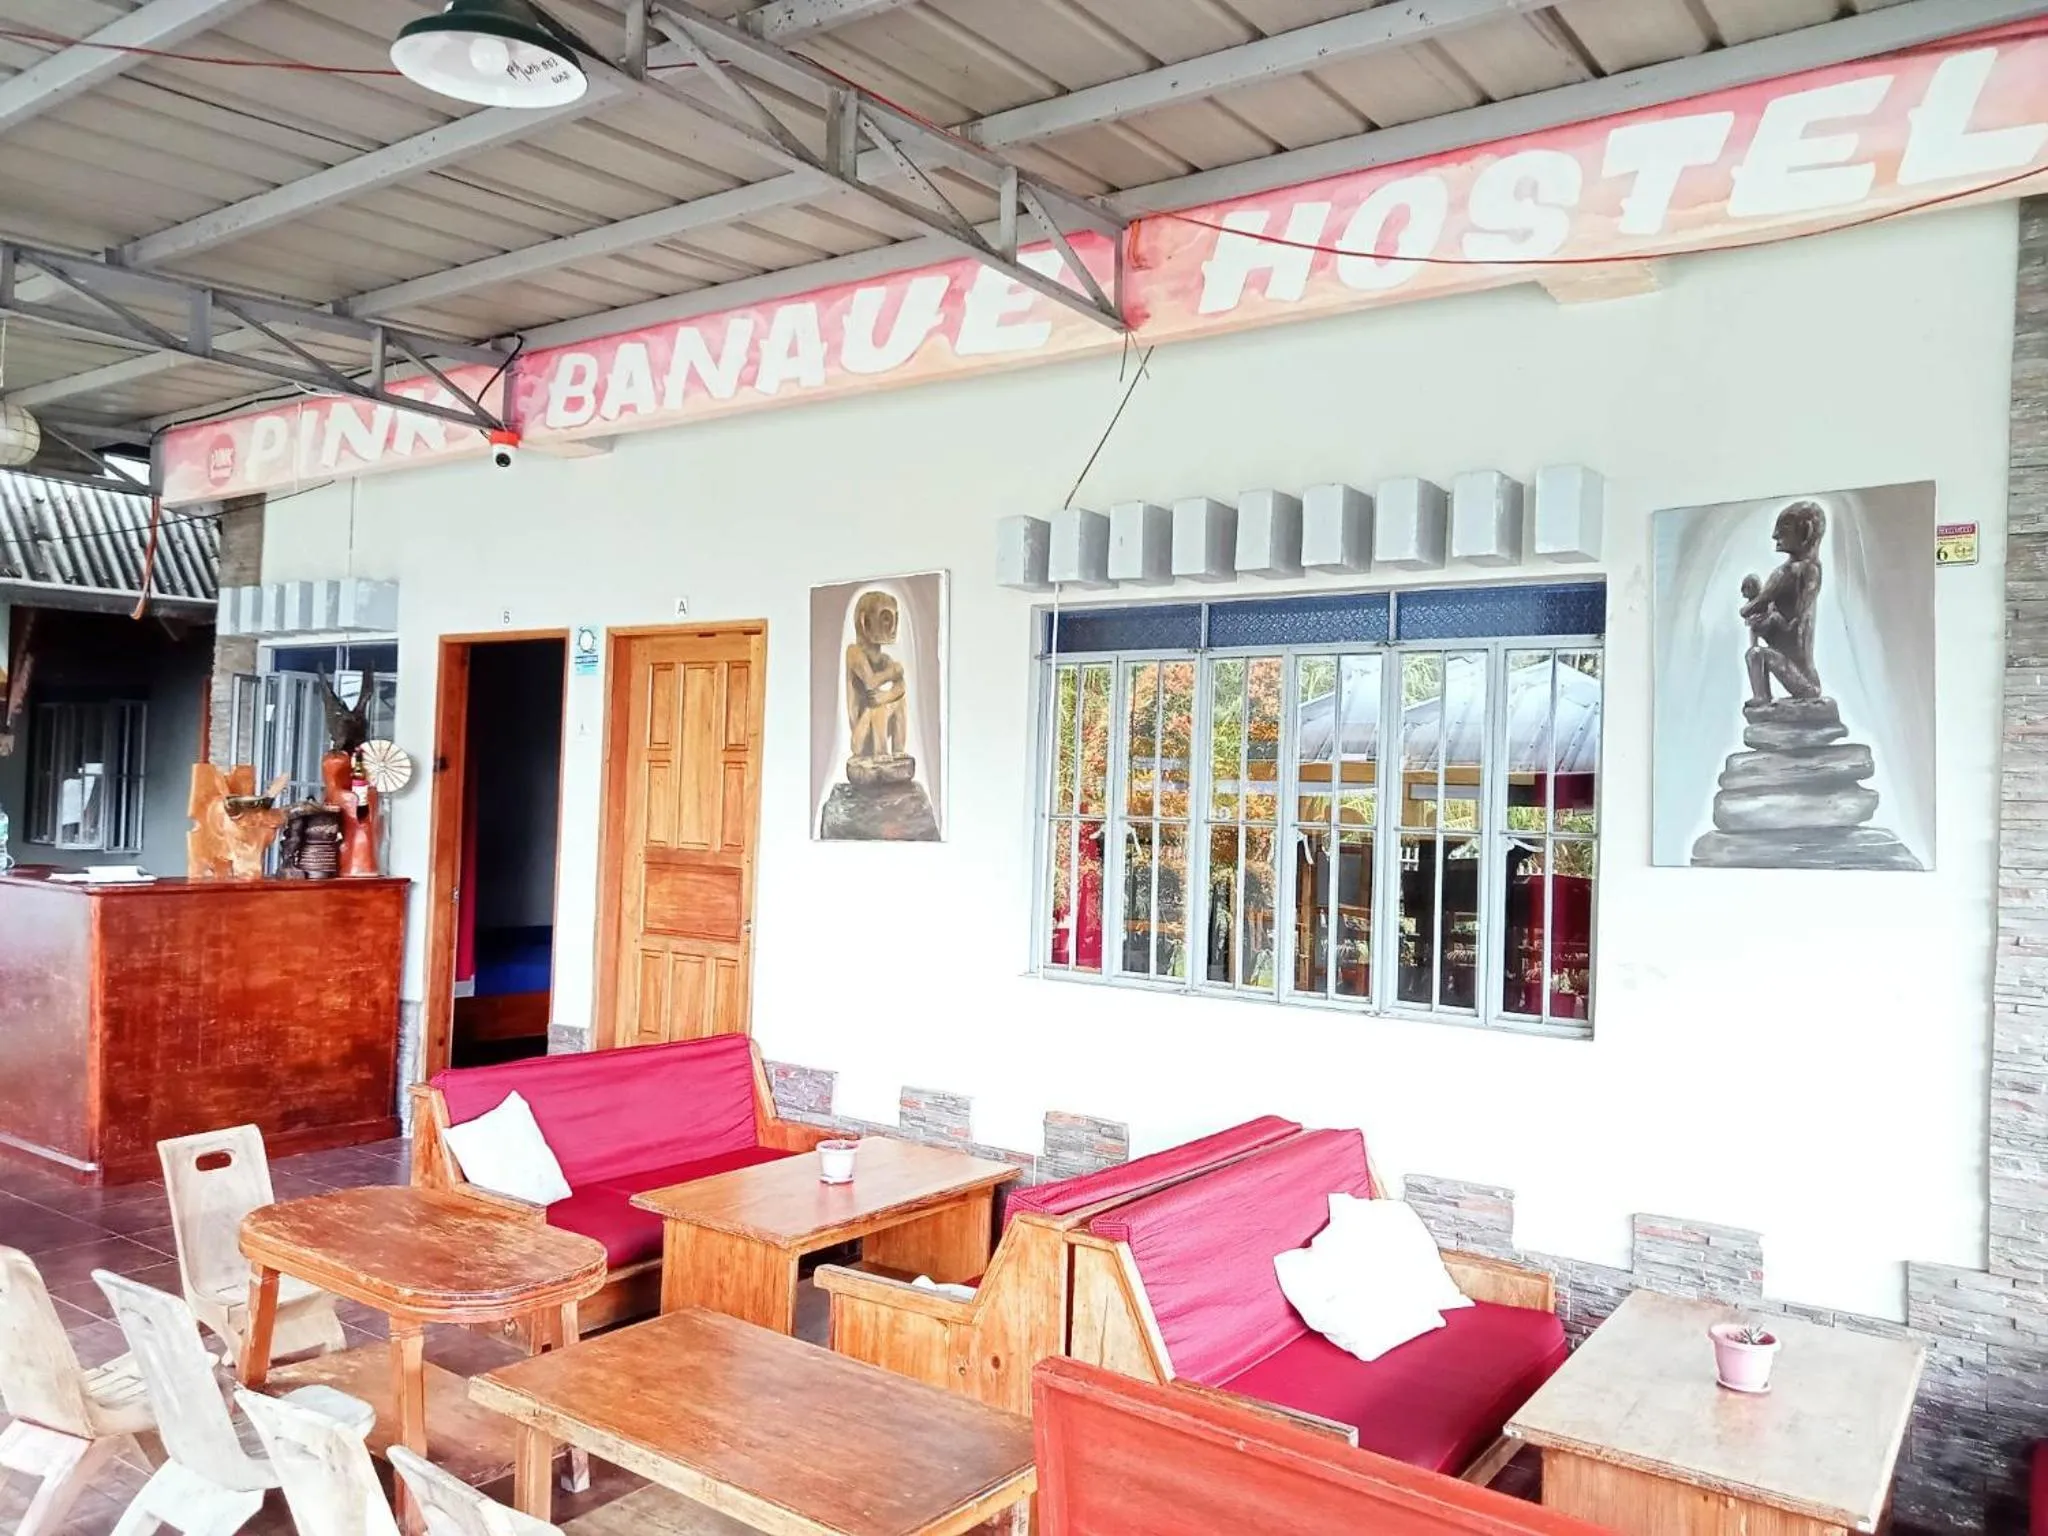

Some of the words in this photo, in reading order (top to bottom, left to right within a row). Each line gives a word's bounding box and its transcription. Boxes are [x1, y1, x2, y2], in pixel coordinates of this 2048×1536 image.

[546, 248, 1065, 428] BANAUE
[1198, 50, 2048, 314] HOSTEL
[678, 601, 688, 615] A
